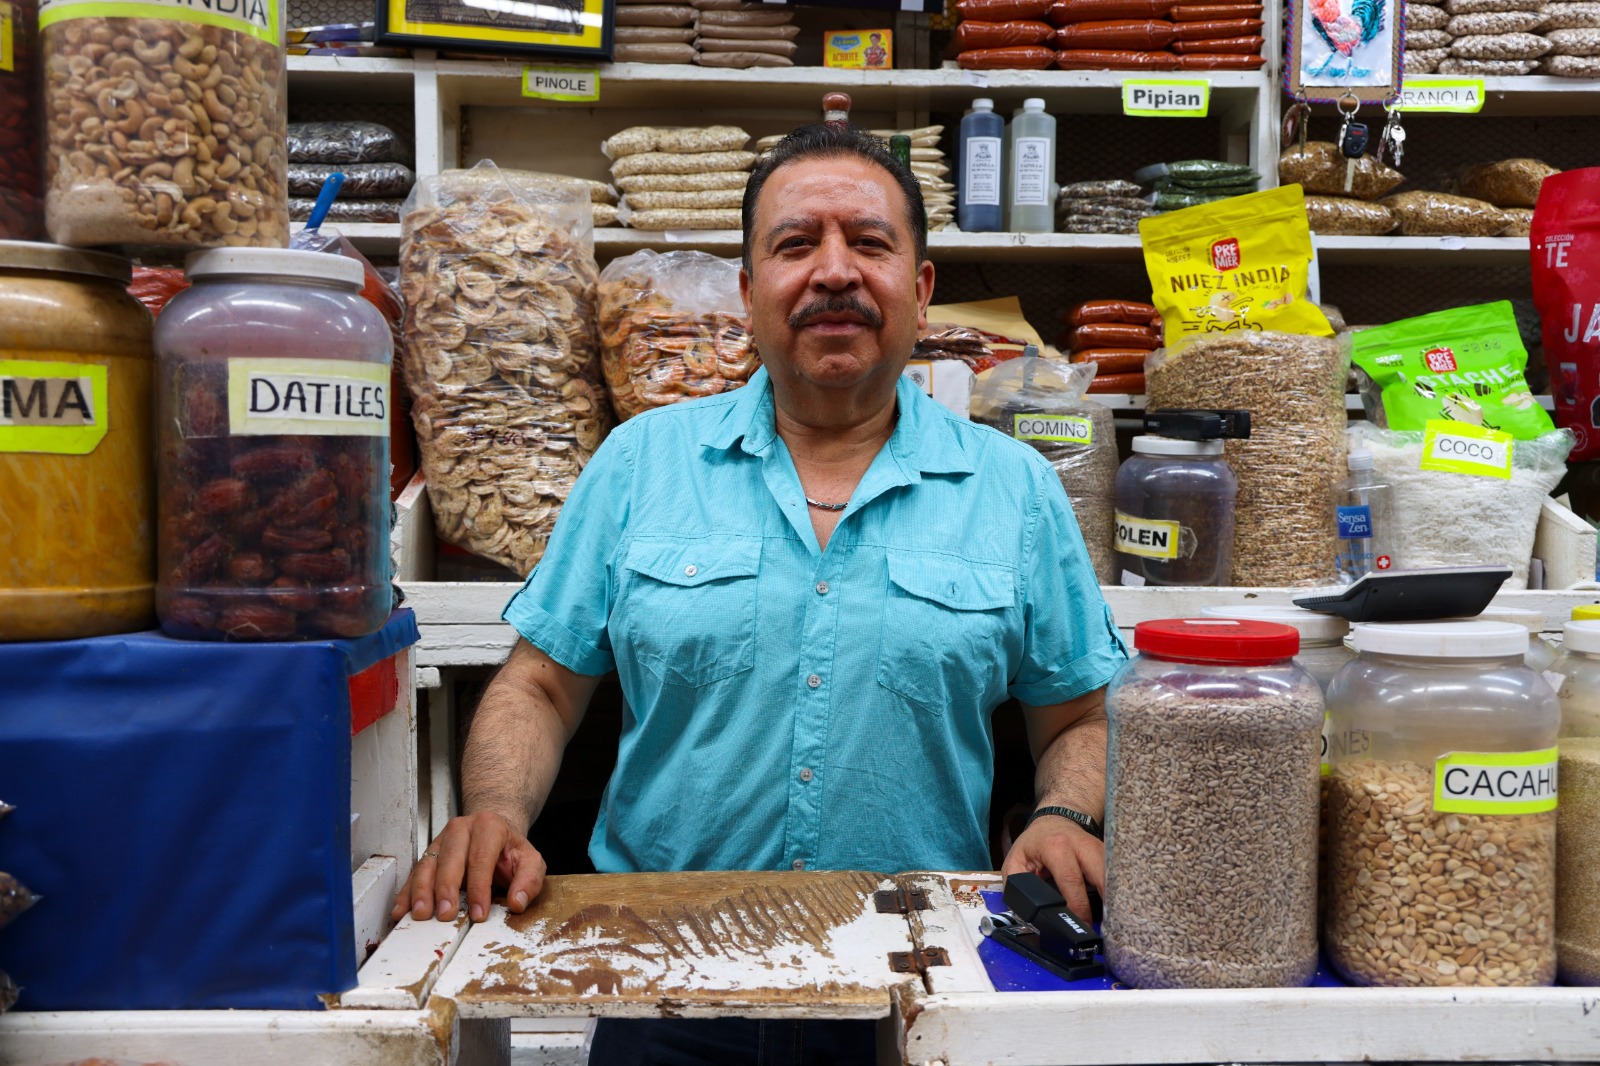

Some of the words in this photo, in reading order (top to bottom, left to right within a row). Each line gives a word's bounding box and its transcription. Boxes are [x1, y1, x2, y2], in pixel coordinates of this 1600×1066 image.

[174, 0, 267, 26] DIA
[535, 76, 587, 91] PINOLE
[1133, 89, 1200, 109] Pipian
[1393, 90, 1476, 105] RANOLA
[1214, 243, 1237, 257] PRE
[1545, 242, 1571, 268] TE
[1170, 273, 1228, 293] NUEZ
[1233, 264, 1291, 288] INDIA
[1428, 352, 1453, 365] PRE
[1397, 363, 1520, 388] STACHE
[249, 378, 385, 419] DATILES
[1018, 420, 1088, 438] COMINO
[1439, 438, 1493, 460] COCO
[1338, 512, 1366, 523] Sensa
[1349, 522, 1368, 533] Zen
